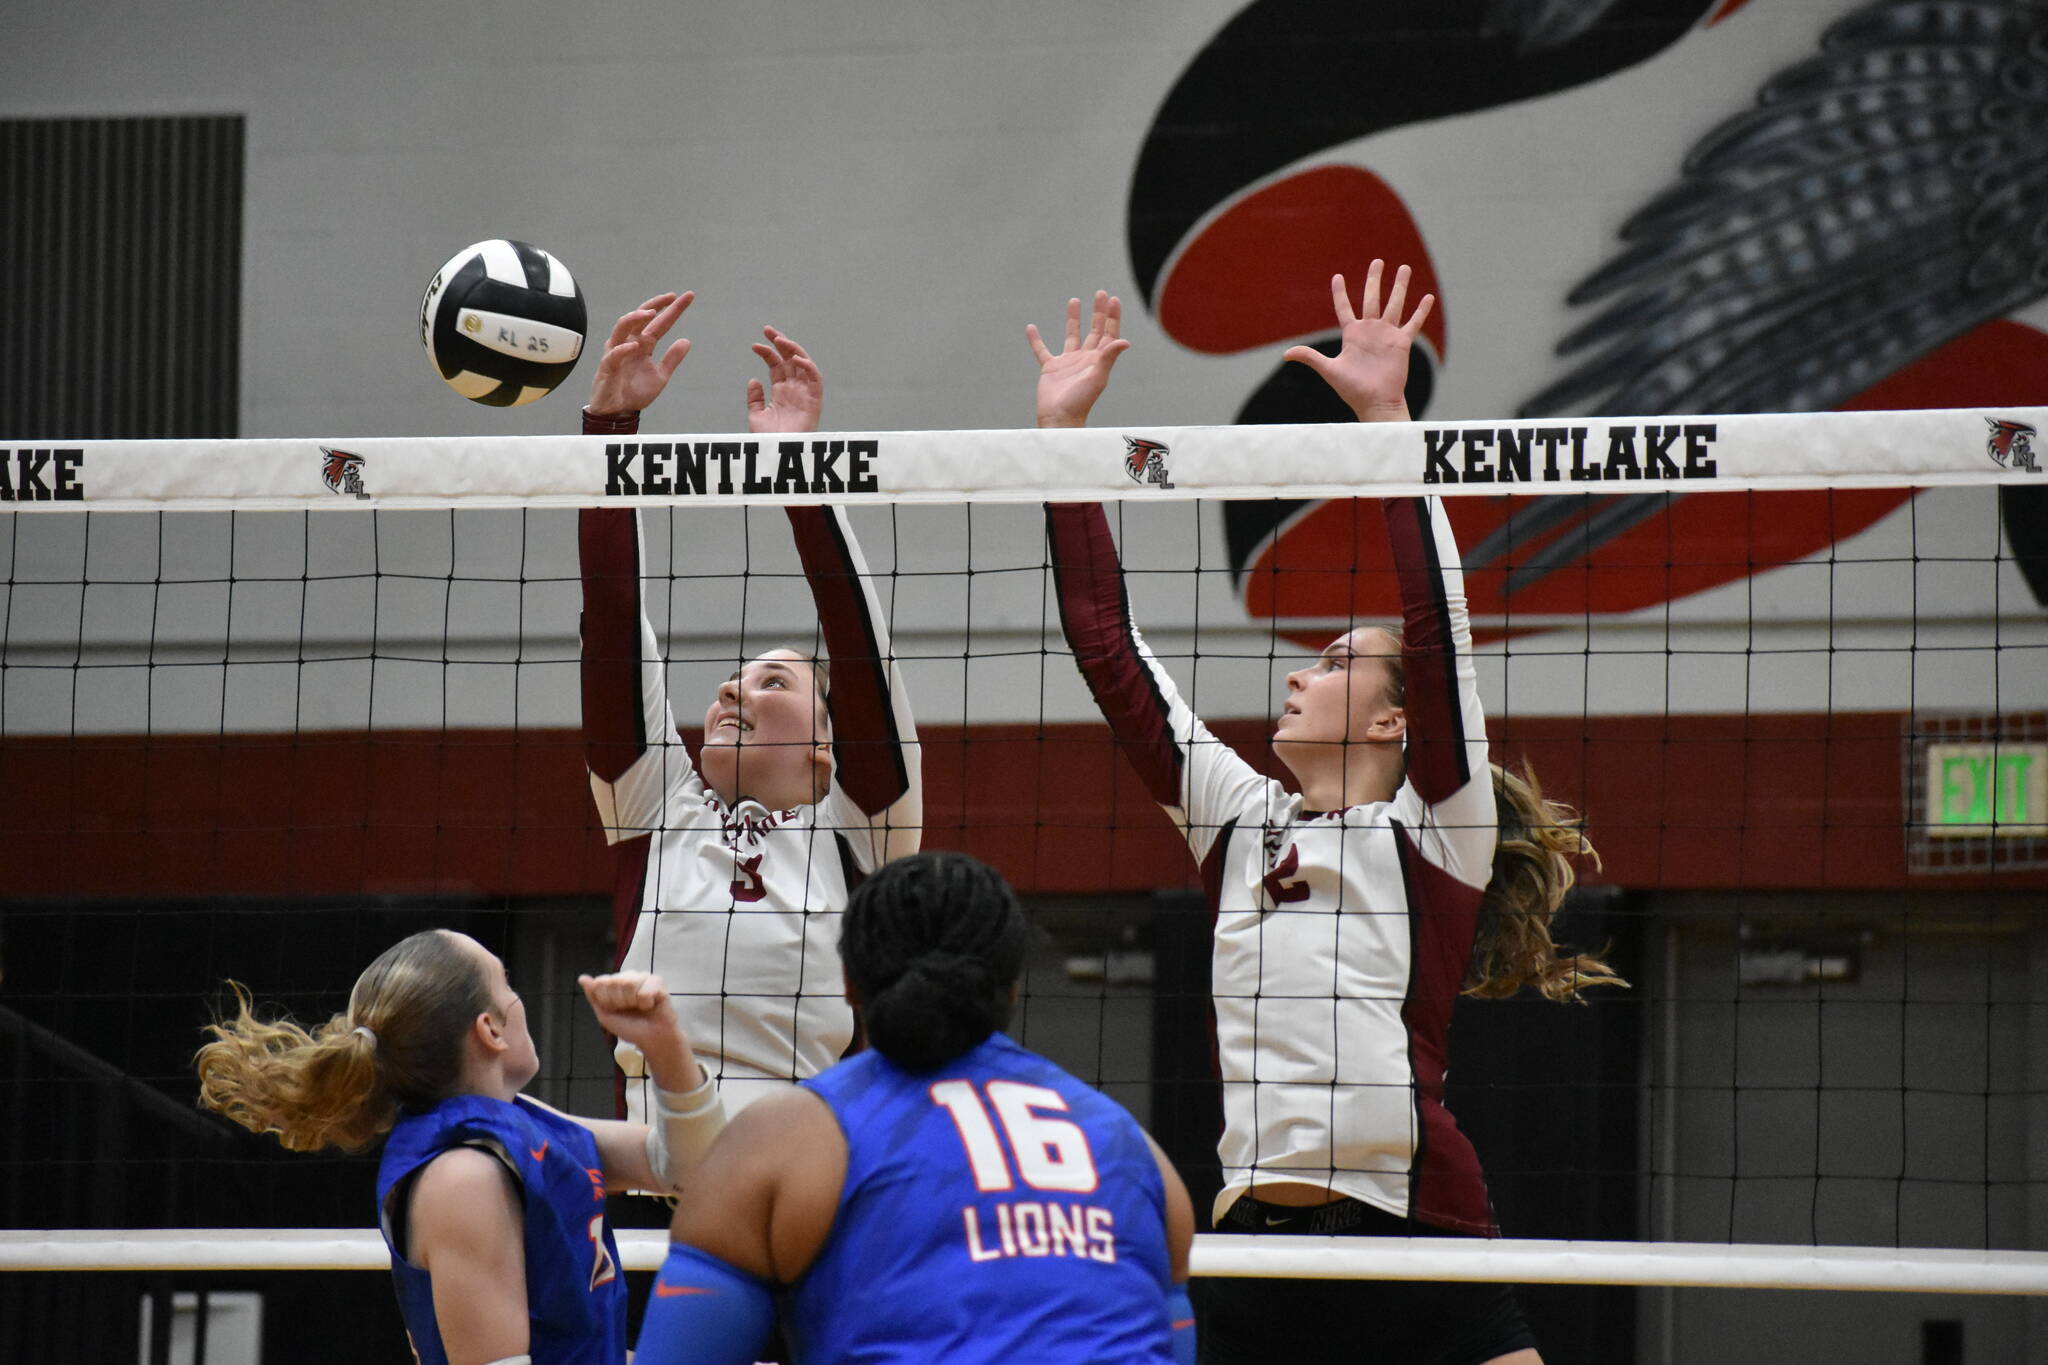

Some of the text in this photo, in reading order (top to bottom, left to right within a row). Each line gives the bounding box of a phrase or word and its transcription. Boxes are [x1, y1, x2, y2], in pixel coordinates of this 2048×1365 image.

[498, 326, 519, 348] KL
[527, 335, 549, 353] 25
[605, 440, 878, 496] KENTLAKE
[1147, 462, 1175, 489] KL
[1423, 424, 1717, 484] KENTLAKE
[2012, 444, 2043, 473] KL
[344, 472, 371, 500] KL
[1941, 754, 2033, 823] EXIT
[928, 1079, 1099, 1194] 16
[962, 1201, 1117, 1265] LIONS
